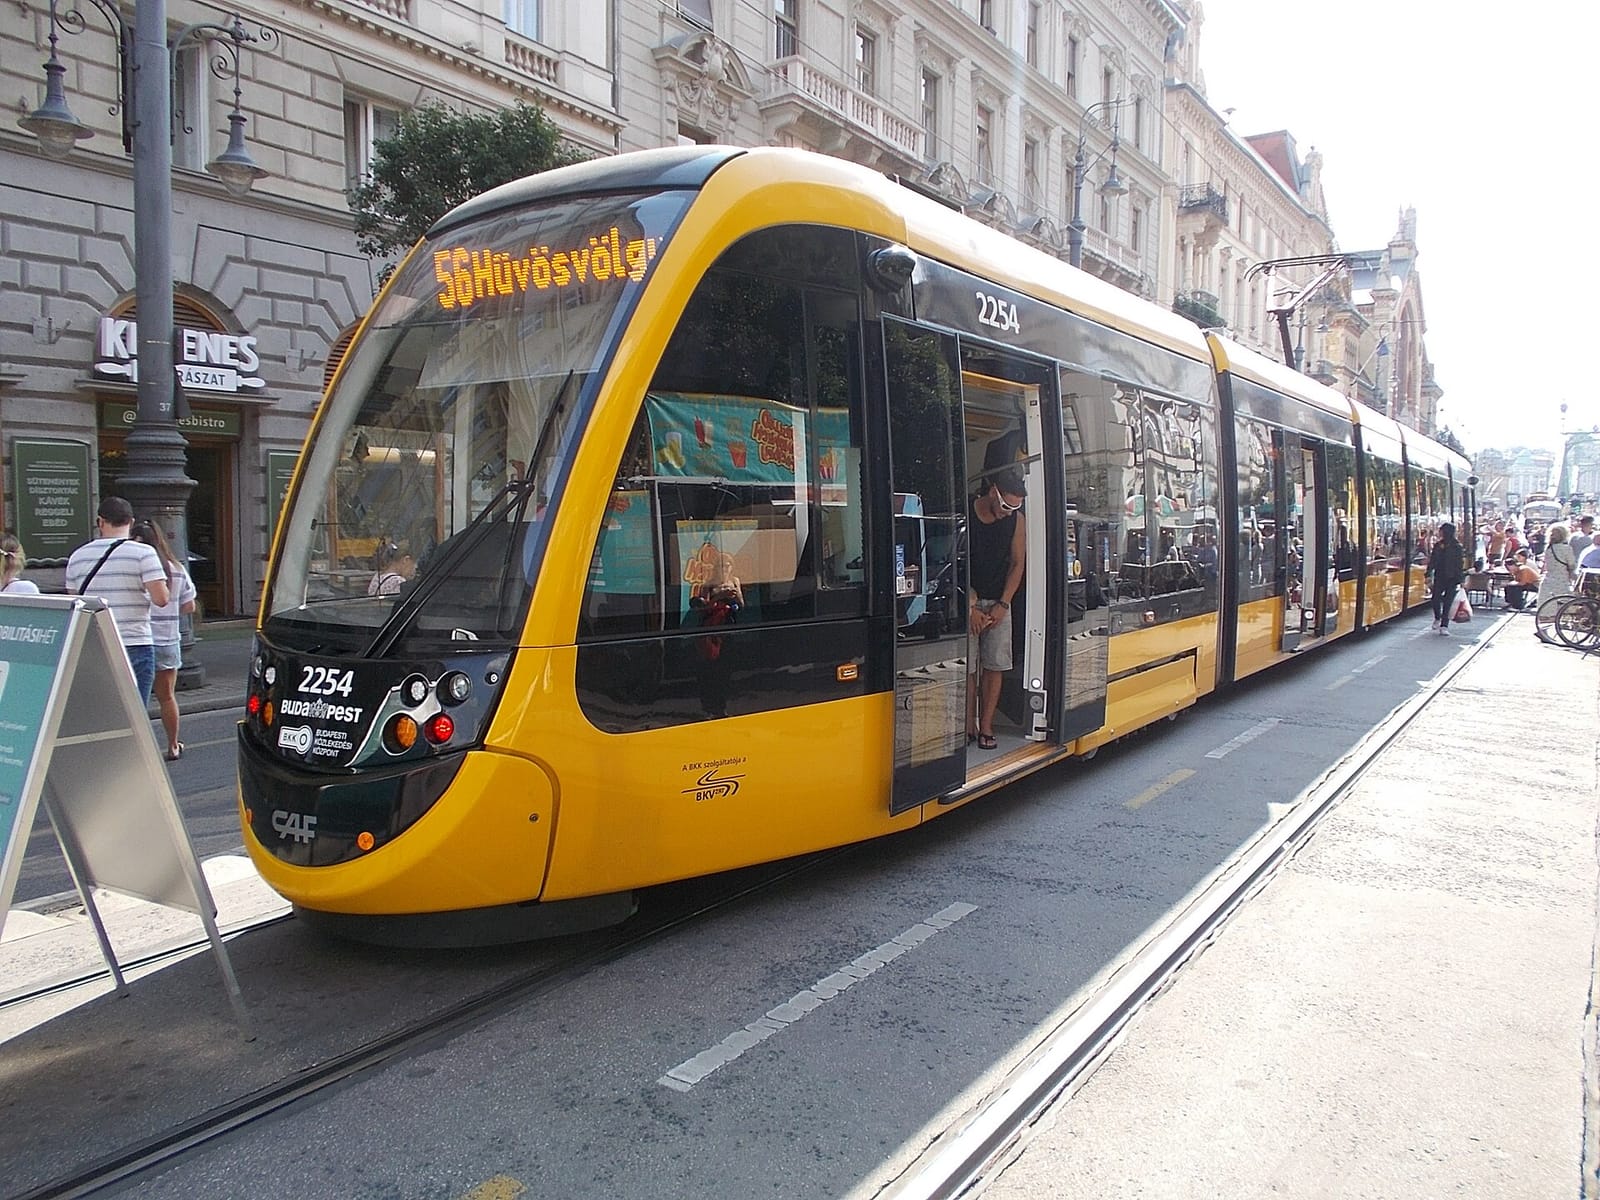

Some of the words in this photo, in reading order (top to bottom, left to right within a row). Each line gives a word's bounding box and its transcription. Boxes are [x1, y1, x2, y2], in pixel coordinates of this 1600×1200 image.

[433, 247, 474, 309] 56
[975, 290, 1021, 334] 2254
[298, 666, 354, 697] 2254
[315, 728, 348, 740] BUDAPESTI
[312, 747, 340, 757] KÖZPONT
[272, 810, 317, 843] CAF
